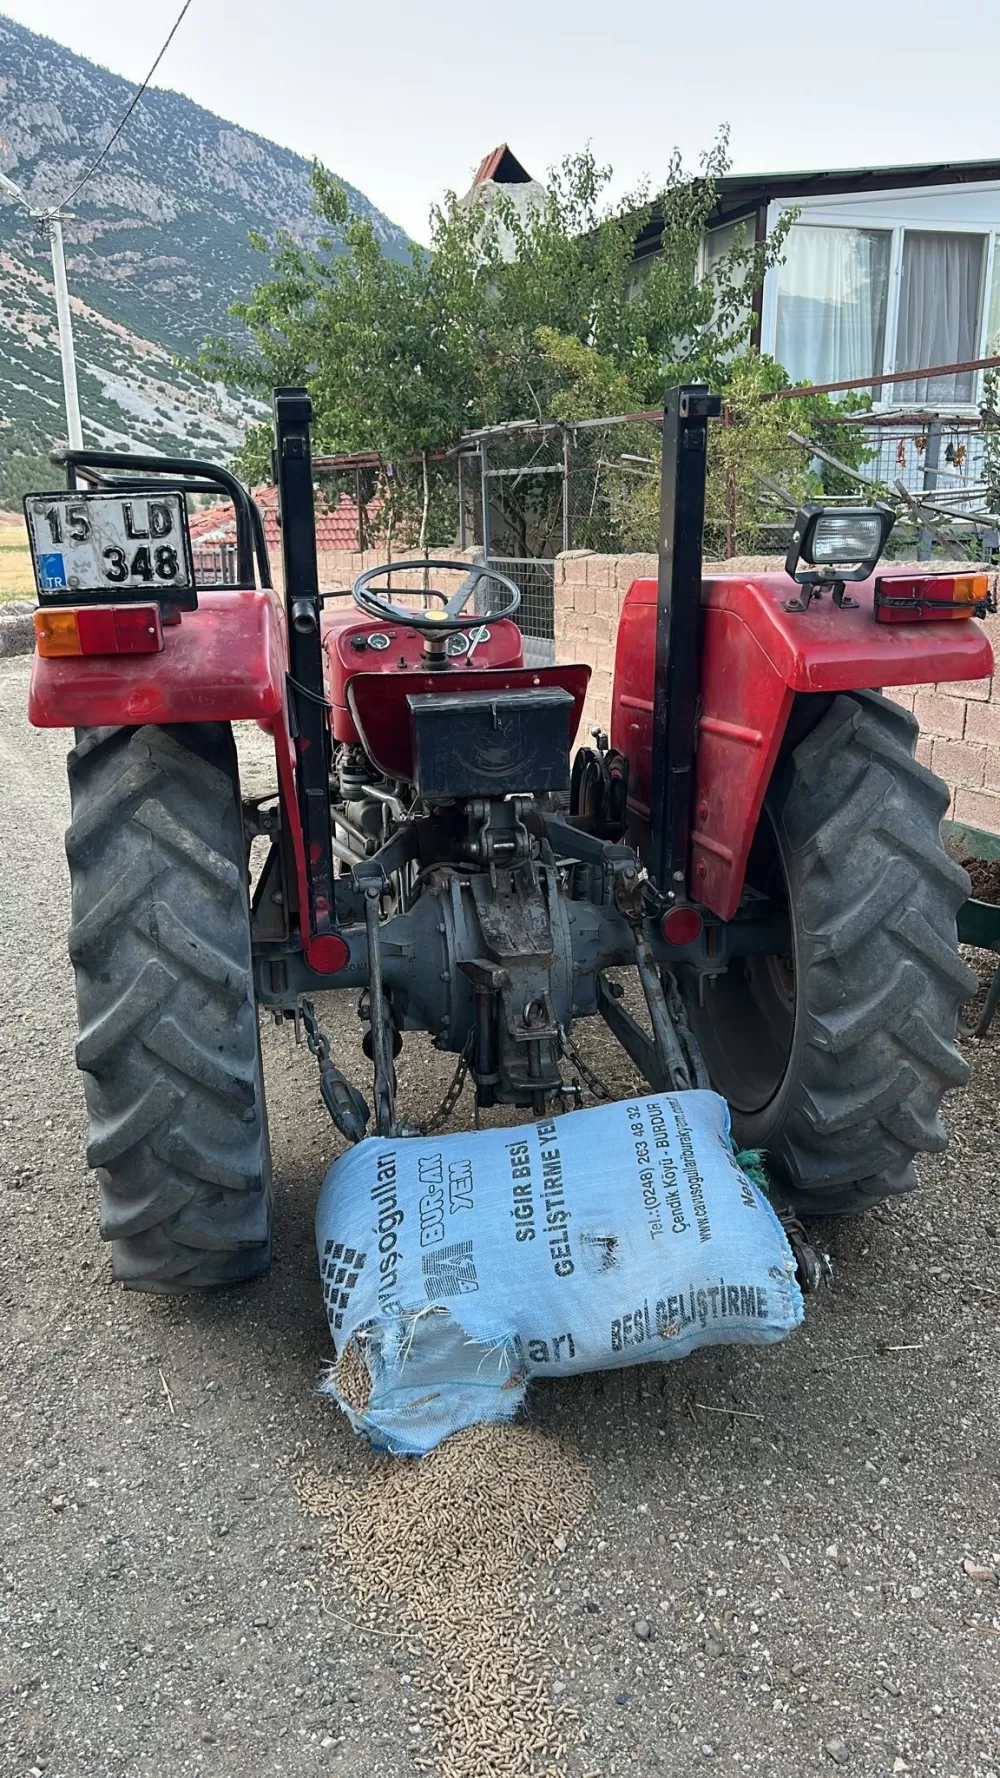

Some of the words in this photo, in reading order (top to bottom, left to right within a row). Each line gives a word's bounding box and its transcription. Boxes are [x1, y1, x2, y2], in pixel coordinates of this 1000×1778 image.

[45, 503, 92, 544] 15
[122, 501, 173, 540] LD
[46, 577, 63, 588] TR
[102, 543, 180, 582] 348
[627, 1105, 641, 1120] 32
[631, 1123, 644, 1138] 48
[646, 1102, 670, 1149] BURDUR
[505, 1140, 531, 1179] BESİ
[635, 1141, 650, 1165] 263
[658, 1157, 678, 1189] Köyü
[418, 1153, 445, 1247] BUR-AK
[449, 1160, 474, 1215] YEM
[510, 1183, 536, 1242] SIĞIR
[540, 1149, 574, 1278] GELİŞTİRME
[666, 1190, 690, 1234] Çendik
[611, 1298, 651, 1352] BESİ
